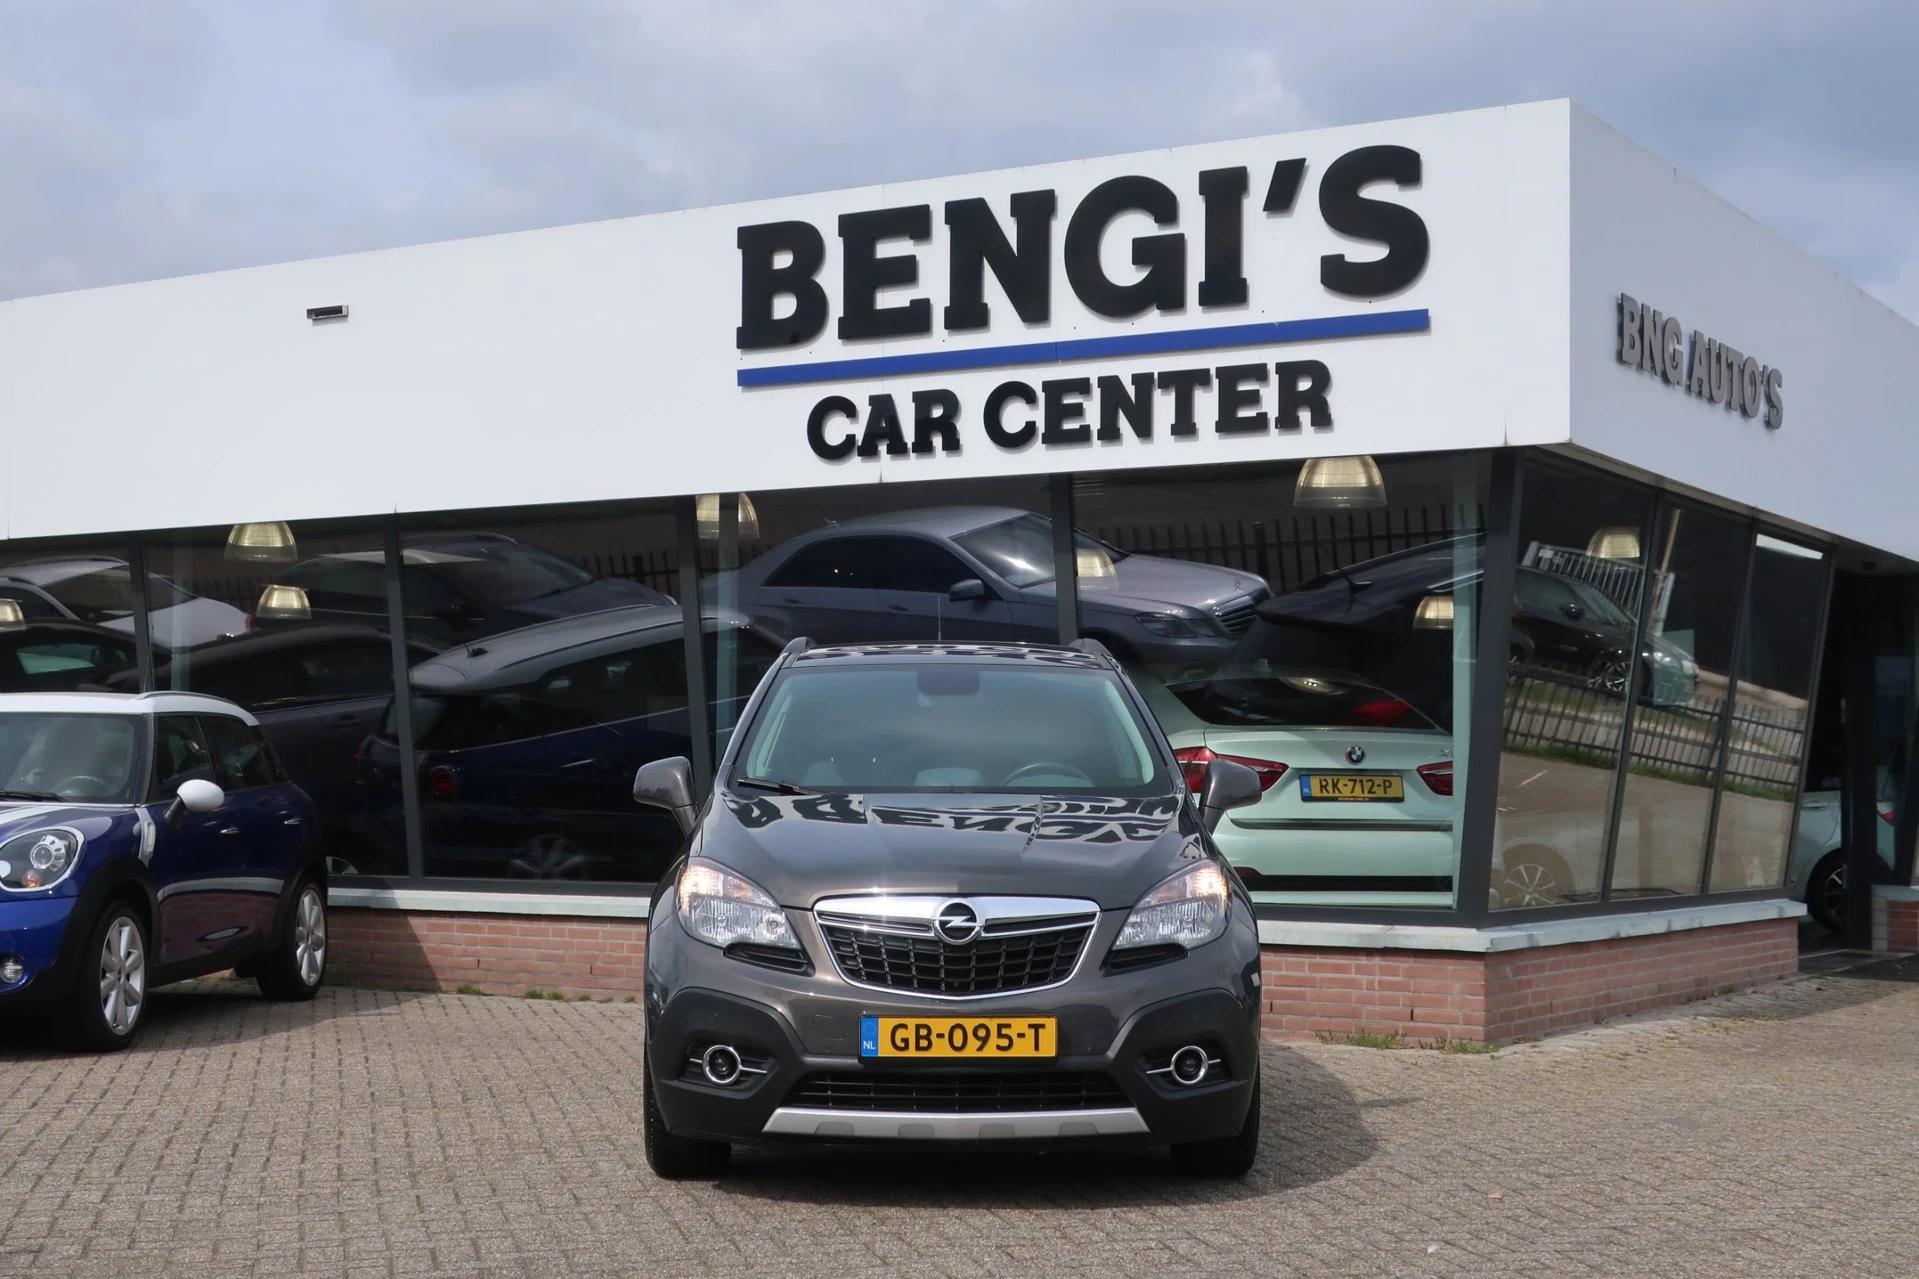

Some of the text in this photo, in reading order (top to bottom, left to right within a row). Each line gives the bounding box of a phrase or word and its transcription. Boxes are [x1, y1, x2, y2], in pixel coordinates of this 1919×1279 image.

[737, 145, 1430, 349] BENGI'S
[807, 360, 1333, 460] CAR CENTER
[1618, 293, 1783, 430] BNG AUTO'S
[1319, 778, 1392, 794] RK-712-P
[863, 1023, 1046, 1052] NL GB-095-T
